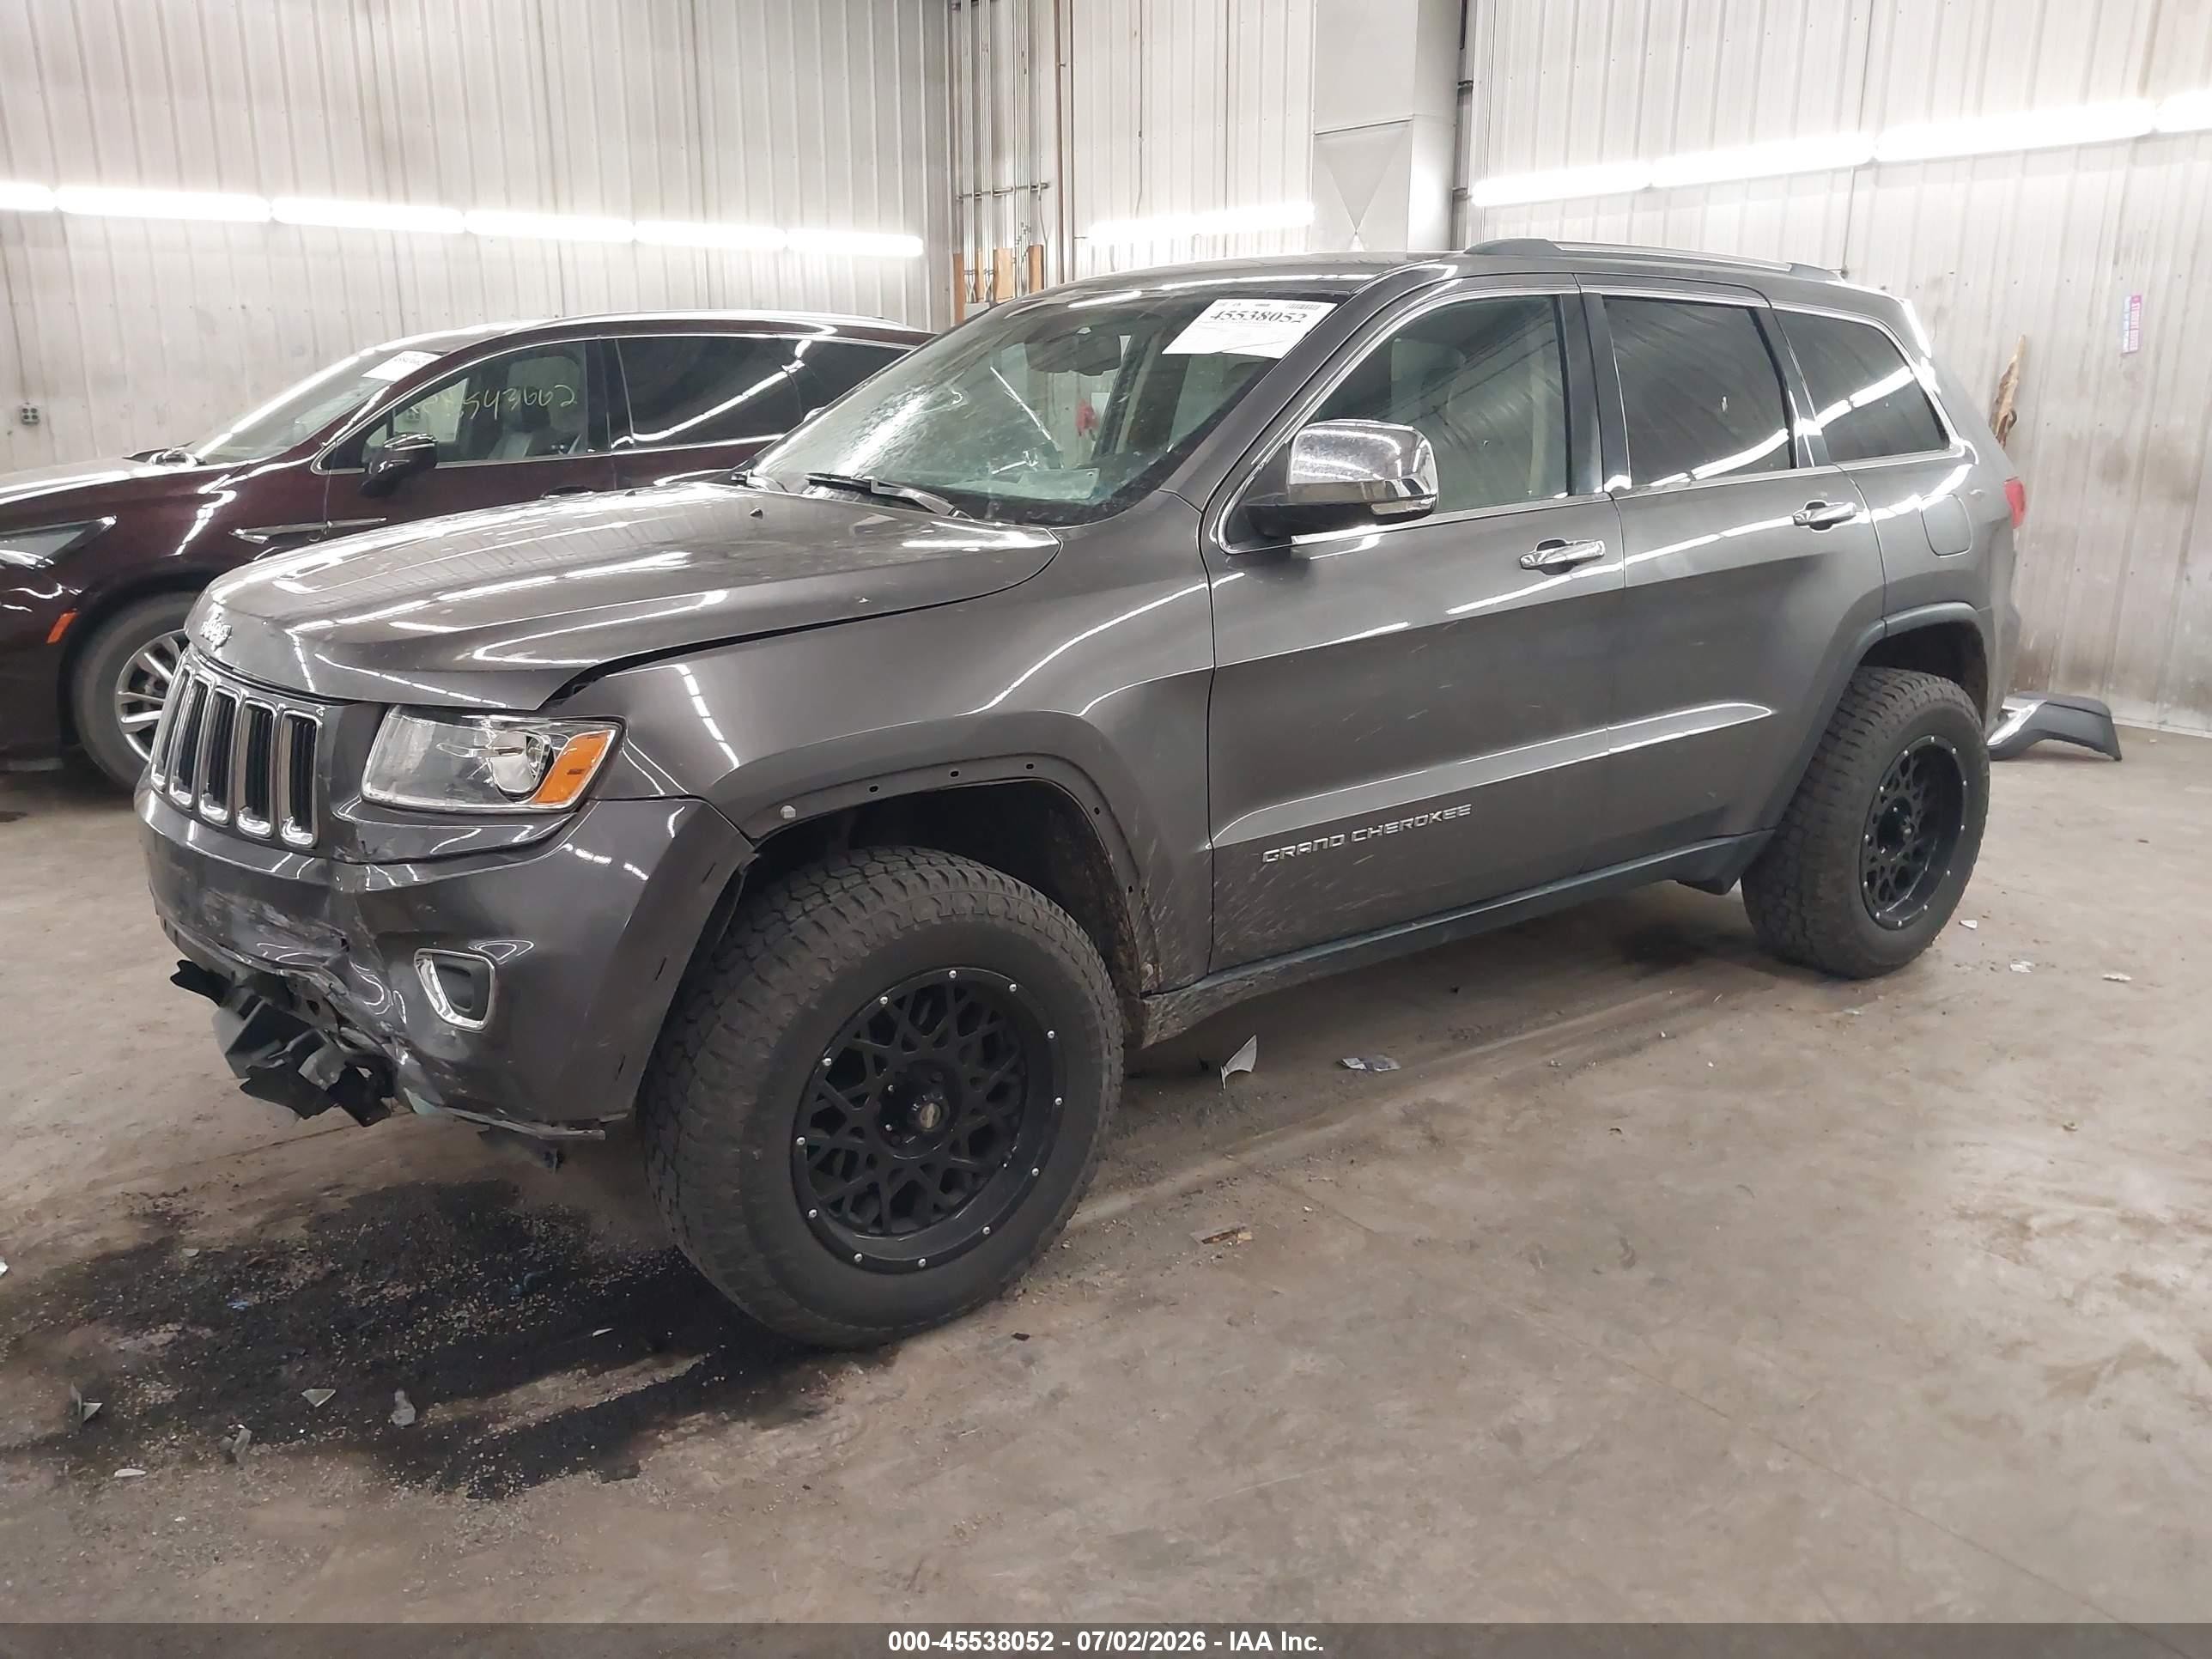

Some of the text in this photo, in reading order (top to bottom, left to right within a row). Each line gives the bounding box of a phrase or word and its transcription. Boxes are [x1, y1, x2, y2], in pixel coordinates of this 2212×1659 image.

[1210, 310, 1308, 324] 45538052
[1262, 804, 1472, 864] GRAND CHEROKEE
